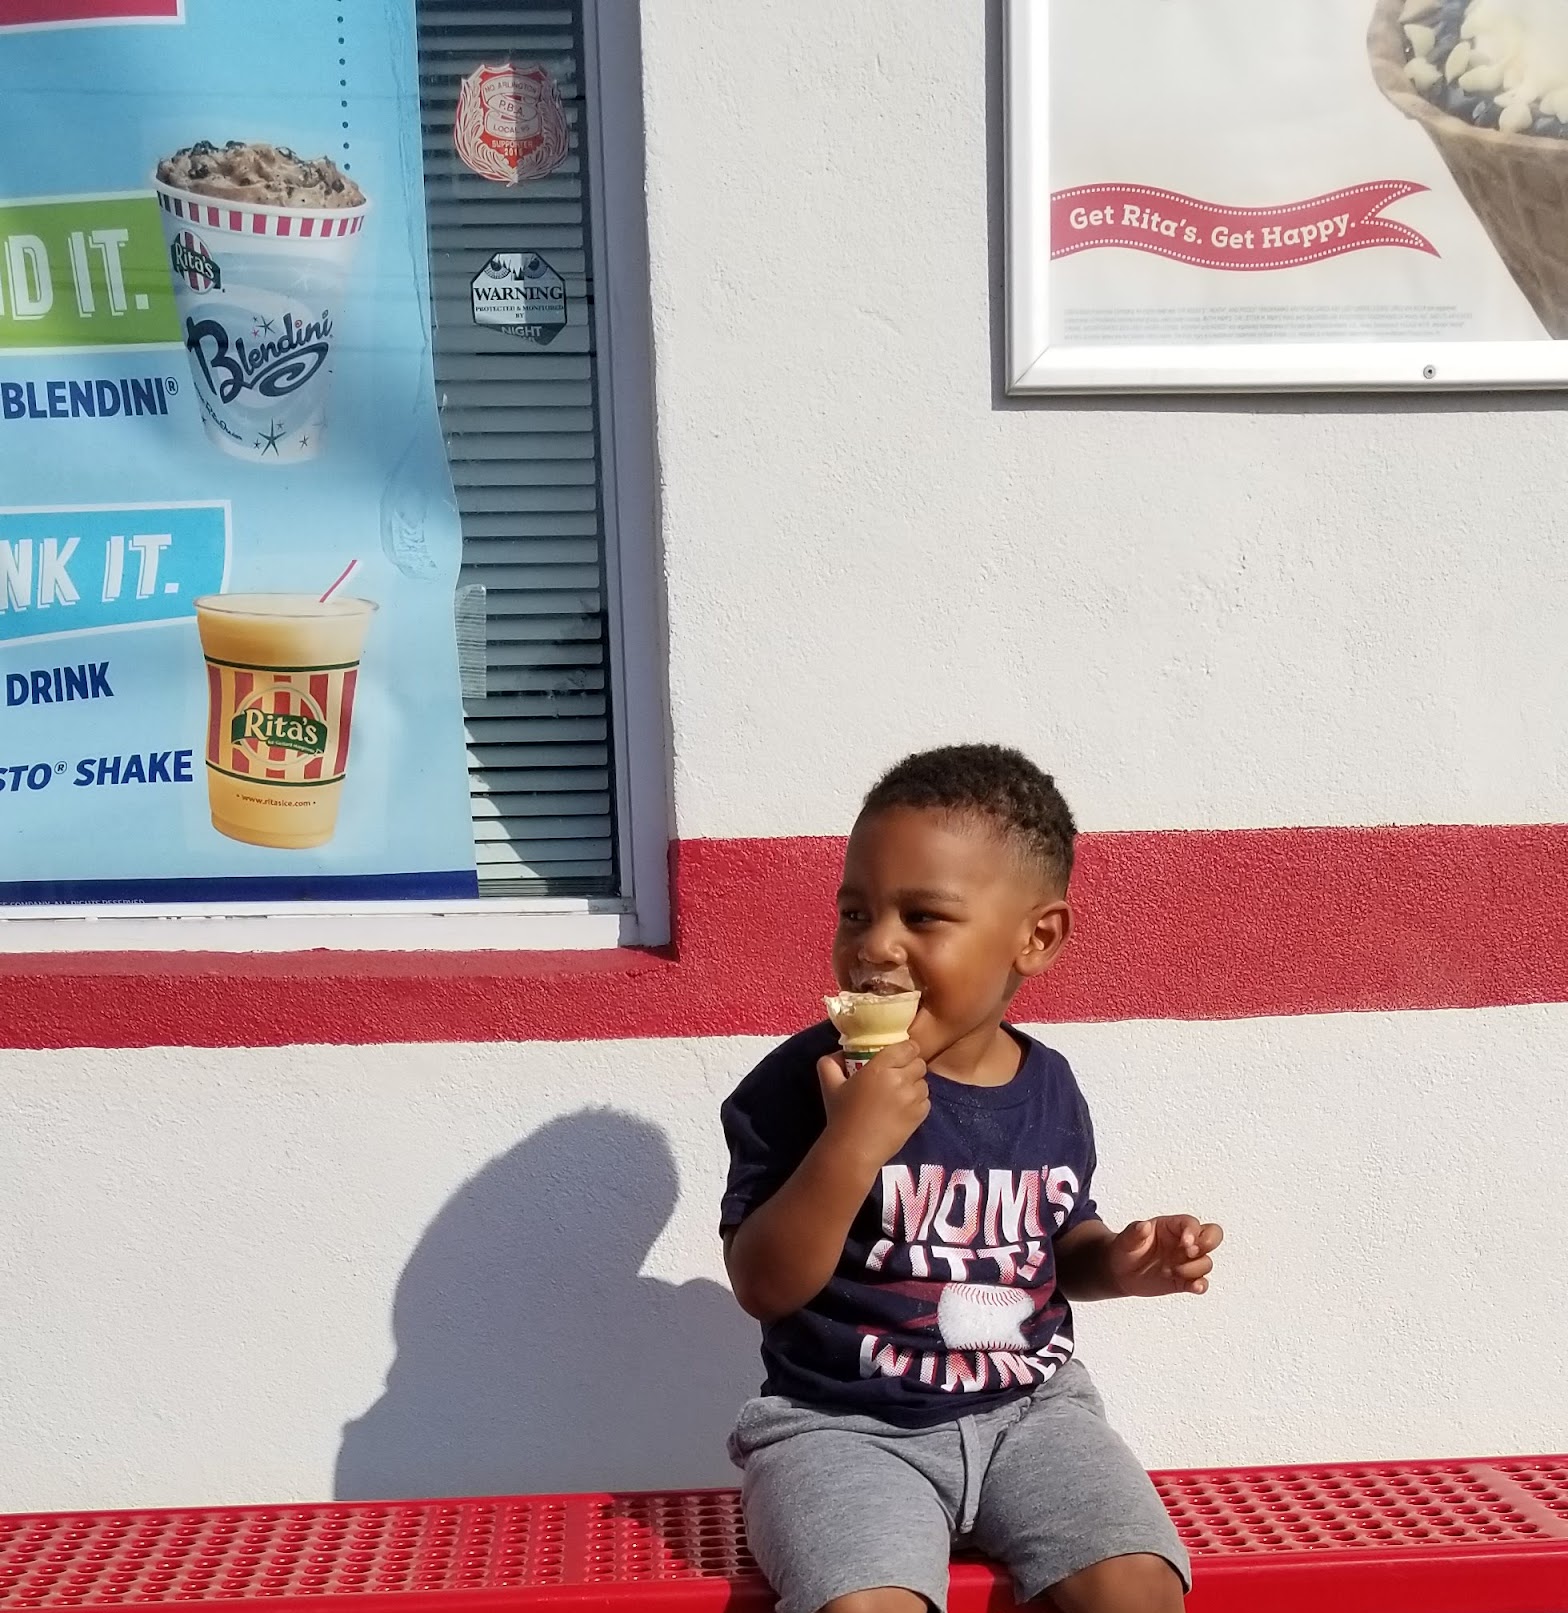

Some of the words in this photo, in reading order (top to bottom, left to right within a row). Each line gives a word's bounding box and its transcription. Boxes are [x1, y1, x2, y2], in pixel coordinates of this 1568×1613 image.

[498, 81, 537, 94] ARLINGTON
[493, 123, 519, 134] LOCAL
[1070, 204, 1114, 230] Get
[1121, 204, 1203, 244] Rita's.
[1211, 226, 1255, 249] Get
[1261, 213, 1356, 248] Happy.
[0, 234, 54, 321] D
[67, 229, 150, 318] IT.
[175, 242, 214, 280] Rita's
[473, 286, 564, 301] WARNING
[501, 325, 542, 337] NIGHT
[186, 309, 333, 404] Blendini
[102, 533, 180, 603] IT.
[6, 661, 115, 707] DRINK
[244, 709, 319, 745] Rita's
[73, 749, 194, 786] SHAKE
[880, 1164, 1080, 1247] MOM'S
